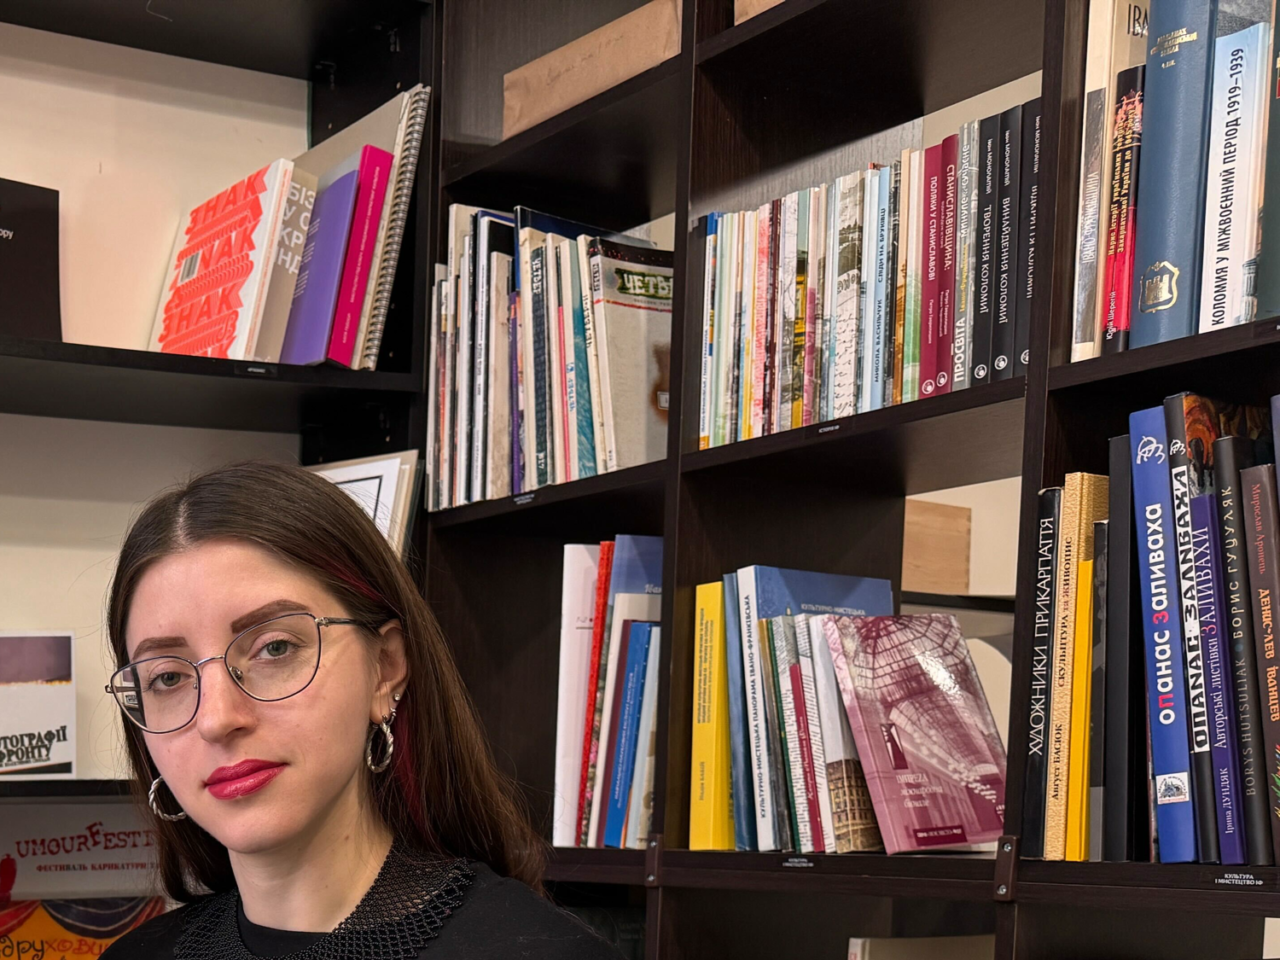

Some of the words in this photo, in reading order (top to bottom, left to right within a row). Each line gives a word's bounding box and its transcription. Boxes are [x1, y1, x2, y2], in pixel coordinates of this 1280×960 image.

[1222, 116, 1241, 164] ПЕРІОД
[943, 164, 955, 271] СТАНИСЛАВІВЩИНА:
[981, 204, 992, 260] ТВОРЕННЯ
[1000, 197, 1011, 272] ВИНАЙДЕННЯ
[1215, 170, 1235, 252] МІЖВОЄННИЙ
[927, 219, 936, 281] СТАНИСЛАВОВІ
[979, 261, 990, 314] КОЛОМИЇ
[998, 273, 1009, 325] КОЛОМИЇ
[1211, 267, 1228, 326] КОЛОМИЯ
[953, 317, 965, 383] ПРОСВІТА
[1034, 517, 1054, 638] ПРИКАРПАТТЯ
[1151, 502, 1169, 624] заливаха
[744, 594, 757, 678] ІВАНО-ФРАНКІВСЬКА
[1230, 581, 1244, 639] БОРИС
[750, 678, 759, 722] ПАНОРАМА
[1028, 646, 1048, 756] ХУДОЖНИКИ
[1158, 630, 1176, 725] опанас
[1238, 656, 1252, 745] HUTSULIAK
[753, 723, 767, 819] КУЛЬТУРНО-МИСТЕЦЬКА
[1246, 749, 1256, 797] BORYS
